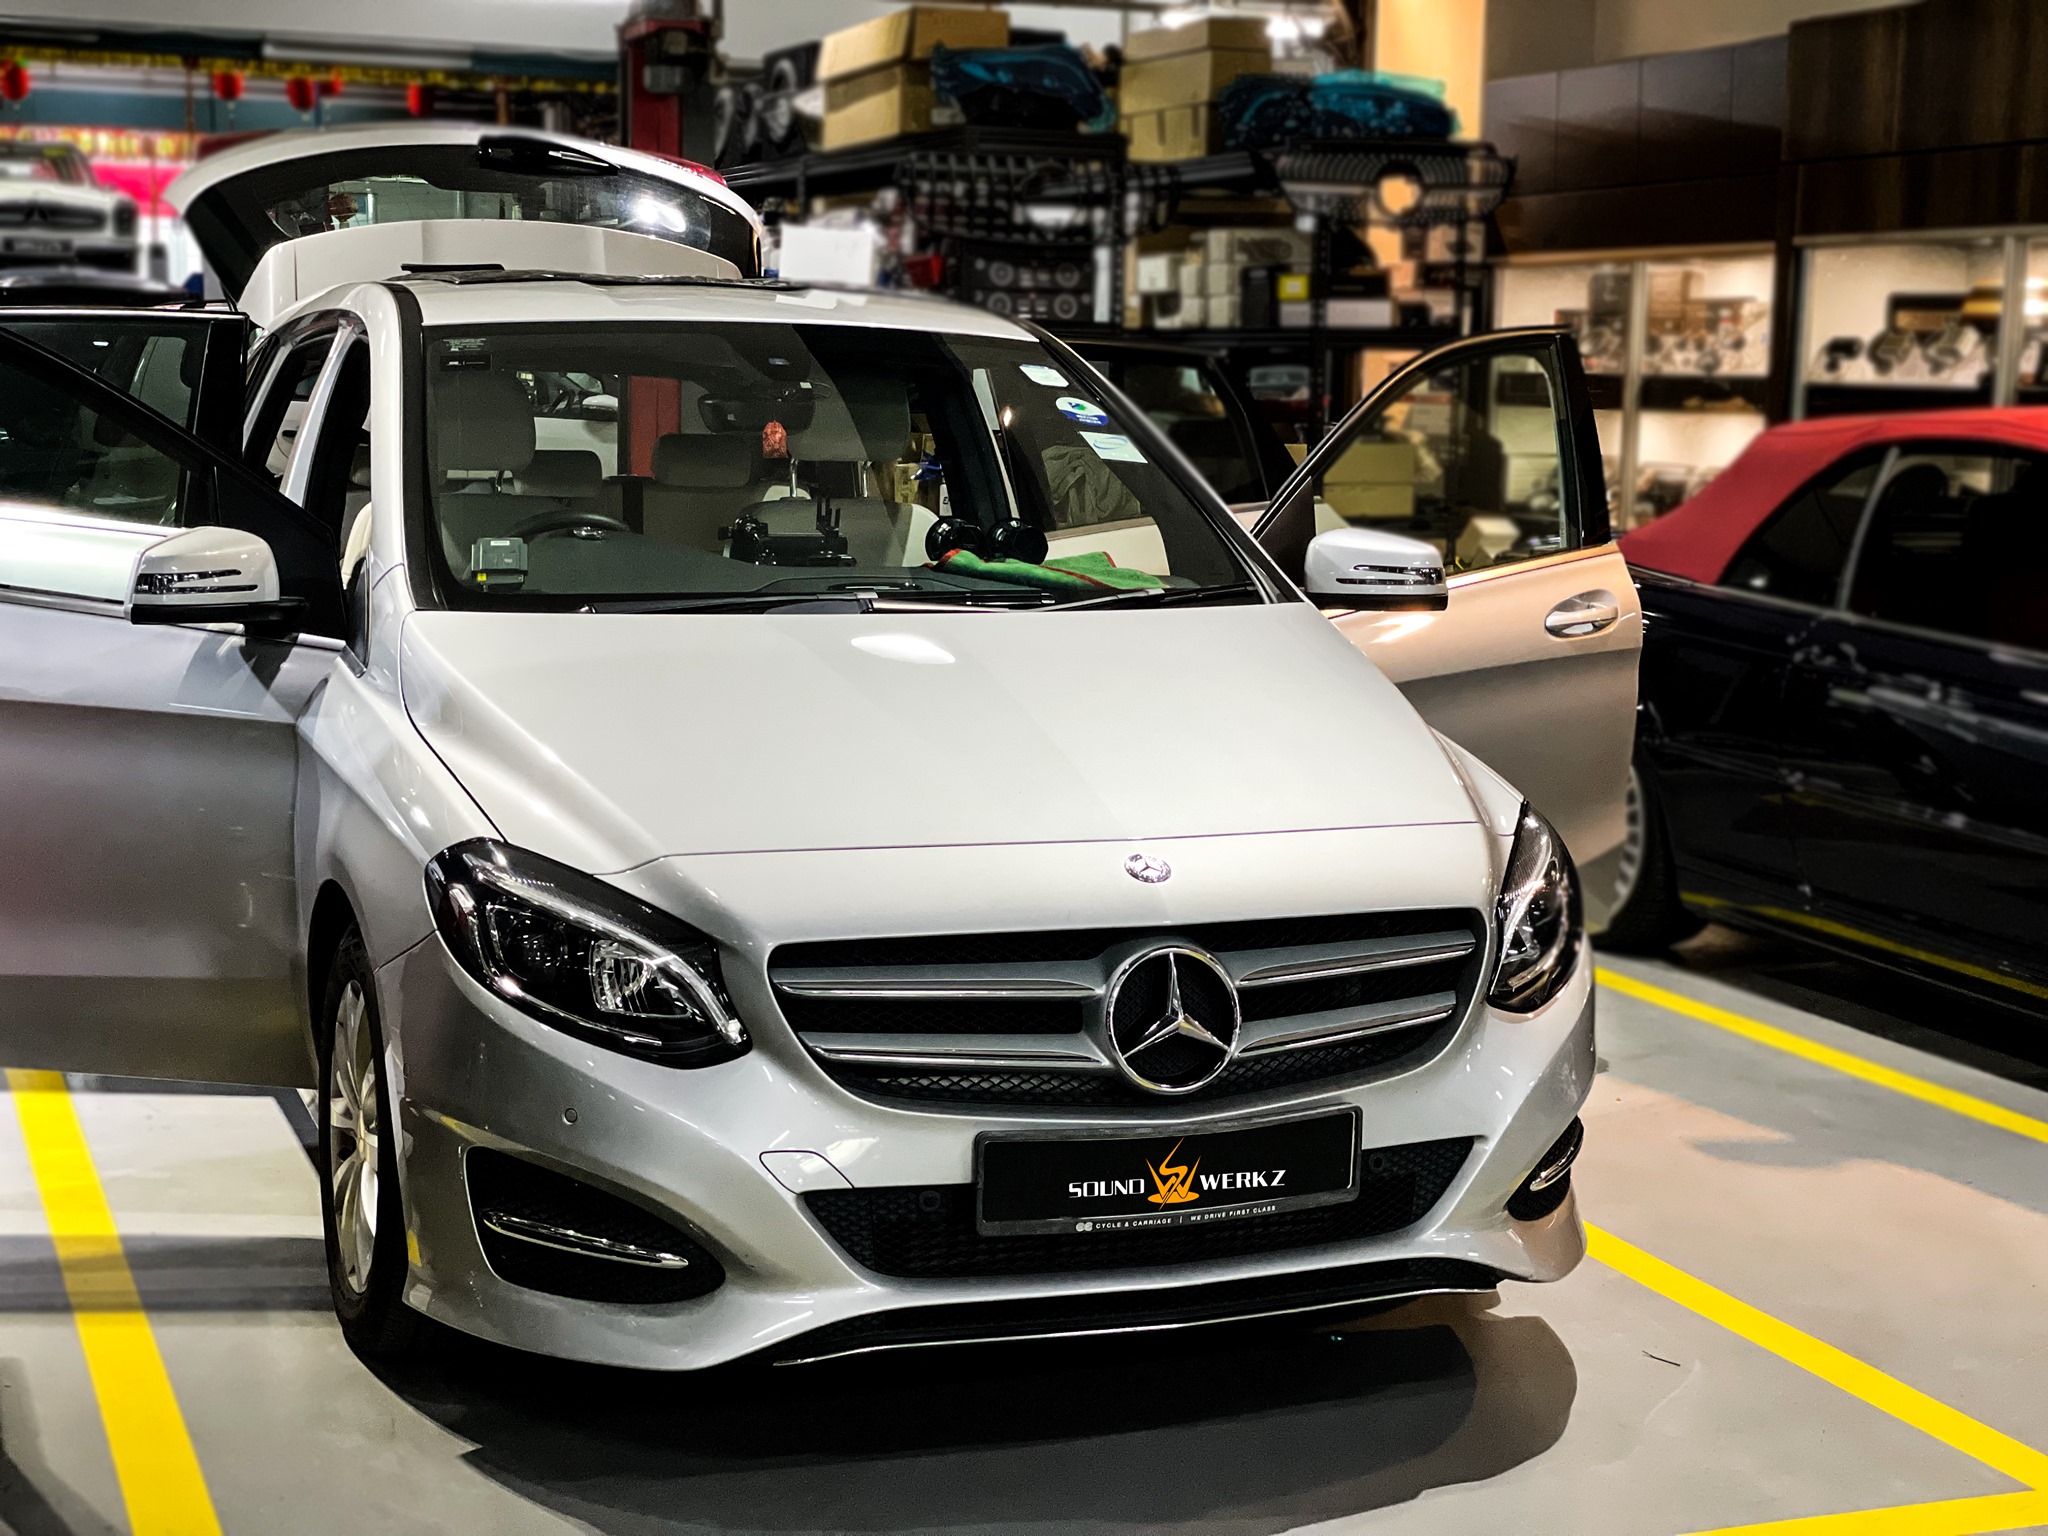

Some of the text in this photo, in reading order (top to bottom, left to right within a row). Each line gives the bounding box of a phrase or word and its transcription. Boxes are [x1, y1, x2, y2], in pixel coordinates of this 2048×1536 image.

[1068, 1178, 1145, 1199] SOUND
[1199, 1169, 1287, 1191] WERKZ
[1204, 1211, 1226, 1220] DRIVE
[1229, 1208, 1251, 1217] FIRST
[1253, 1205, 1276, 1214] CLASS
[1095, 1221, 1122, 1229] CYCLE
[1132, 1218, 1172, 1227] CARRIAGE
